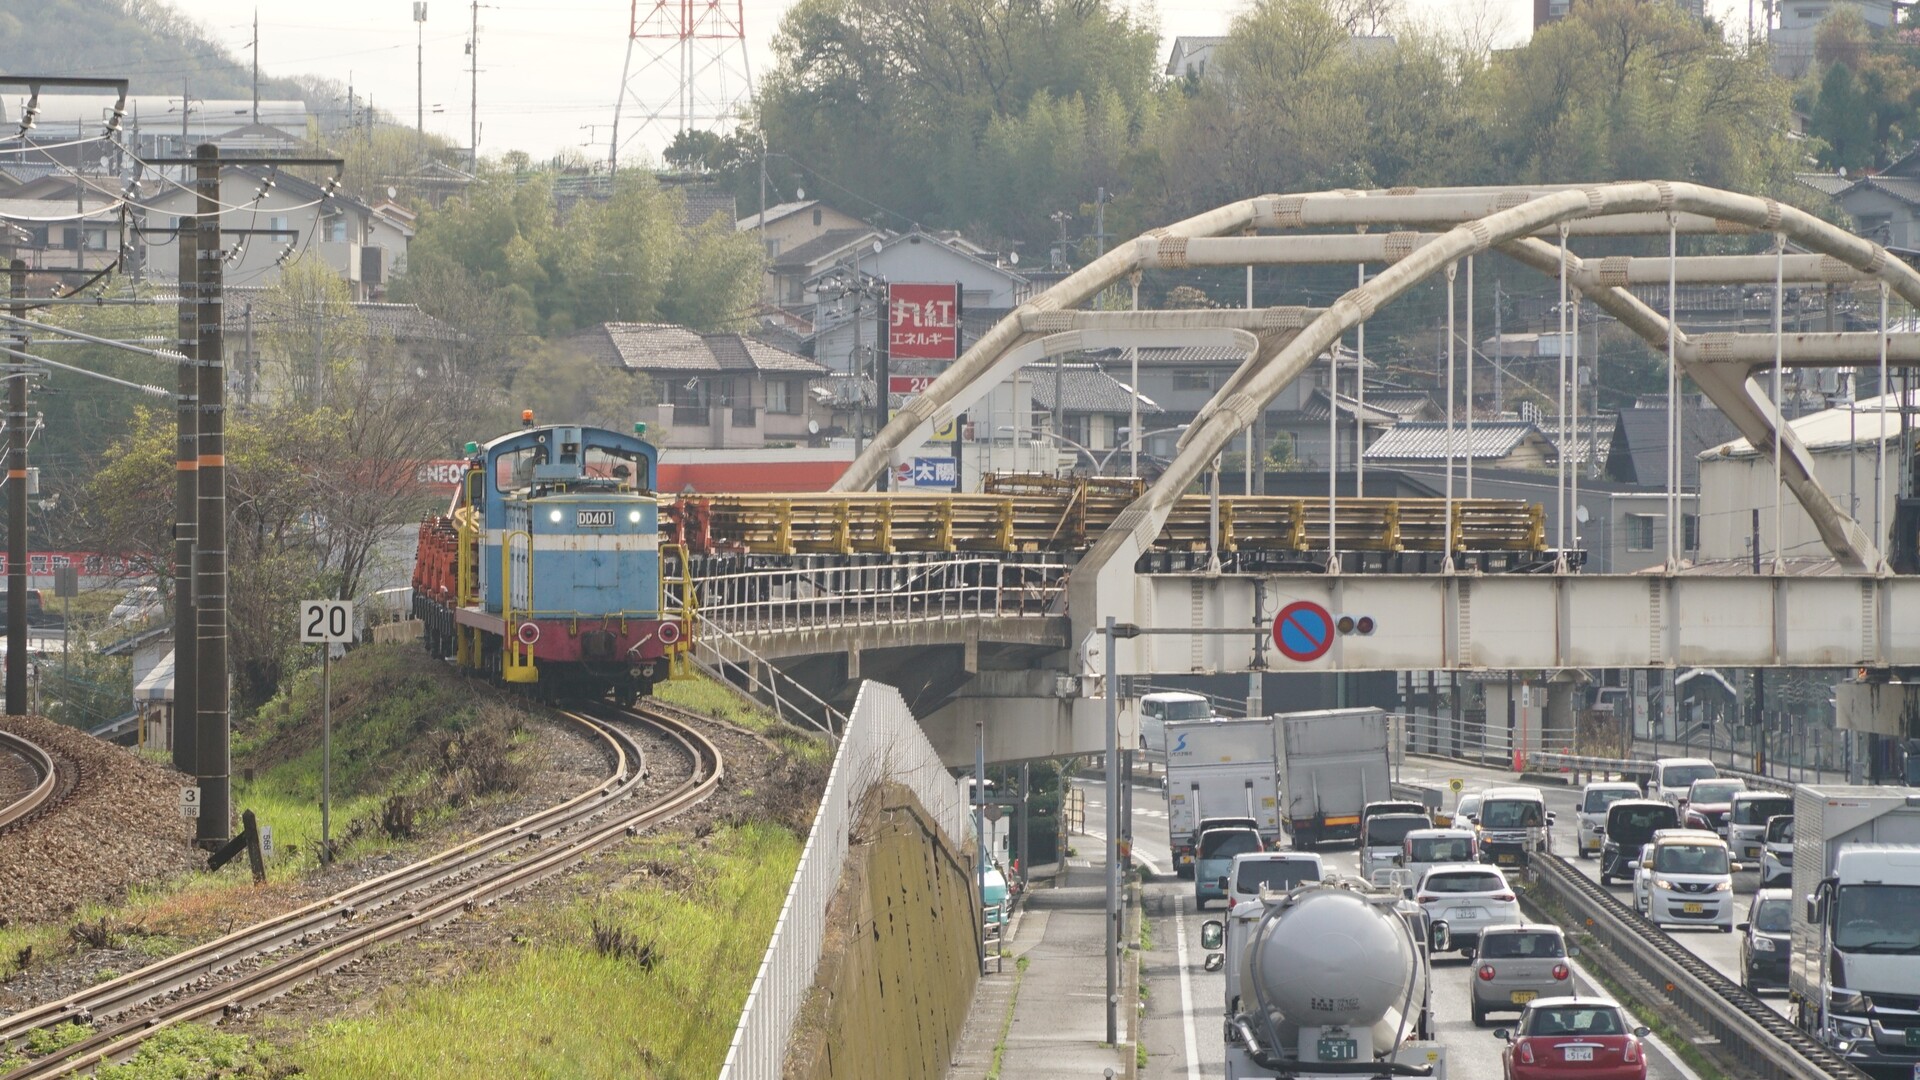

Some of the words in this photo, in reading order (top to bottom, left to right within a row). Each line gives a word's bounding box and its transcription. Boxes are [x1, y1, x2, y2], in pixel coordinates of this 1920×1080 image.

[891, 299, 954, 328] 丸紅
[891, 333, 955, 345] エネルギー
[911, 379, 928, 393] 24
[915, 462, 955, 482] 太陽
[579, 512, 612, 525] DD401
[307, 605, 346, 637] 20
[185, 789, 196, 802] 3
[183, 806, 197, 816] 196
[1331, 1045, 1354, 1058] 511
